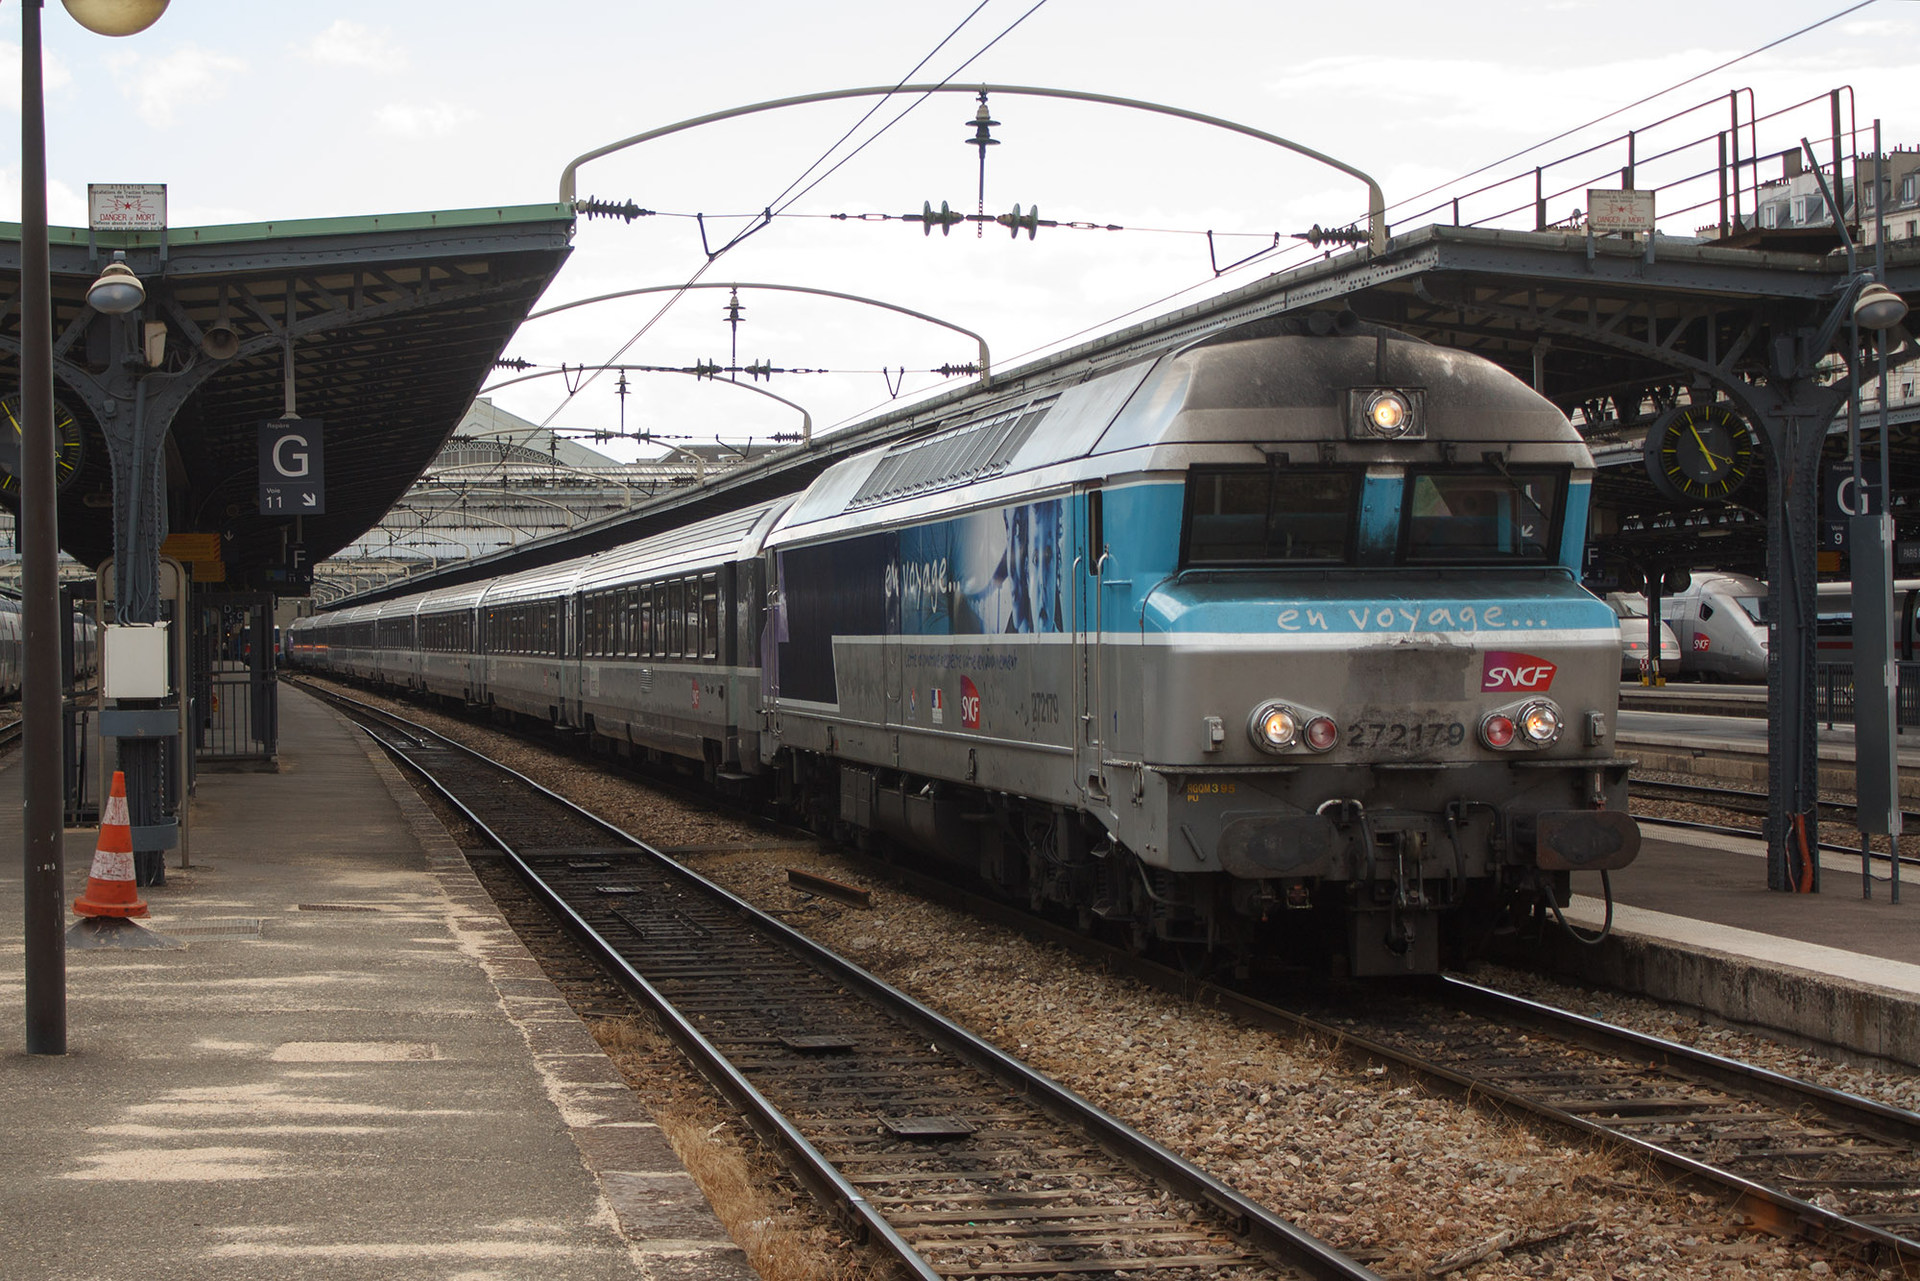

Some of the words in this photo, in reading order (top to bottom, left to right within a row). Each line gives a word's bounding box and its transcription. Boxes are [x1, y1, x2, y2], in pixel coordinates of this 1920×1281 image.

[100, 213, 127, 221] DANGER
[136, 213, 156, 221] MORT
[272, 434, 309, 477] G
[266, 496, 282, 509] 11
[1837, 476, 1869, 515] G
[1834, 532, 1843, 544] 9
[294, 550, 307, 569] F
[1588, 547, 1599, 566] F
[1277, 609, 1329, 631] en
[1693, 639, 1710, 649] SNCF
[1484, 666, 1553, 688] SNCF
[961, 695, 979, 722] SNCF
[1347, 722, 1466, 748] 272179
